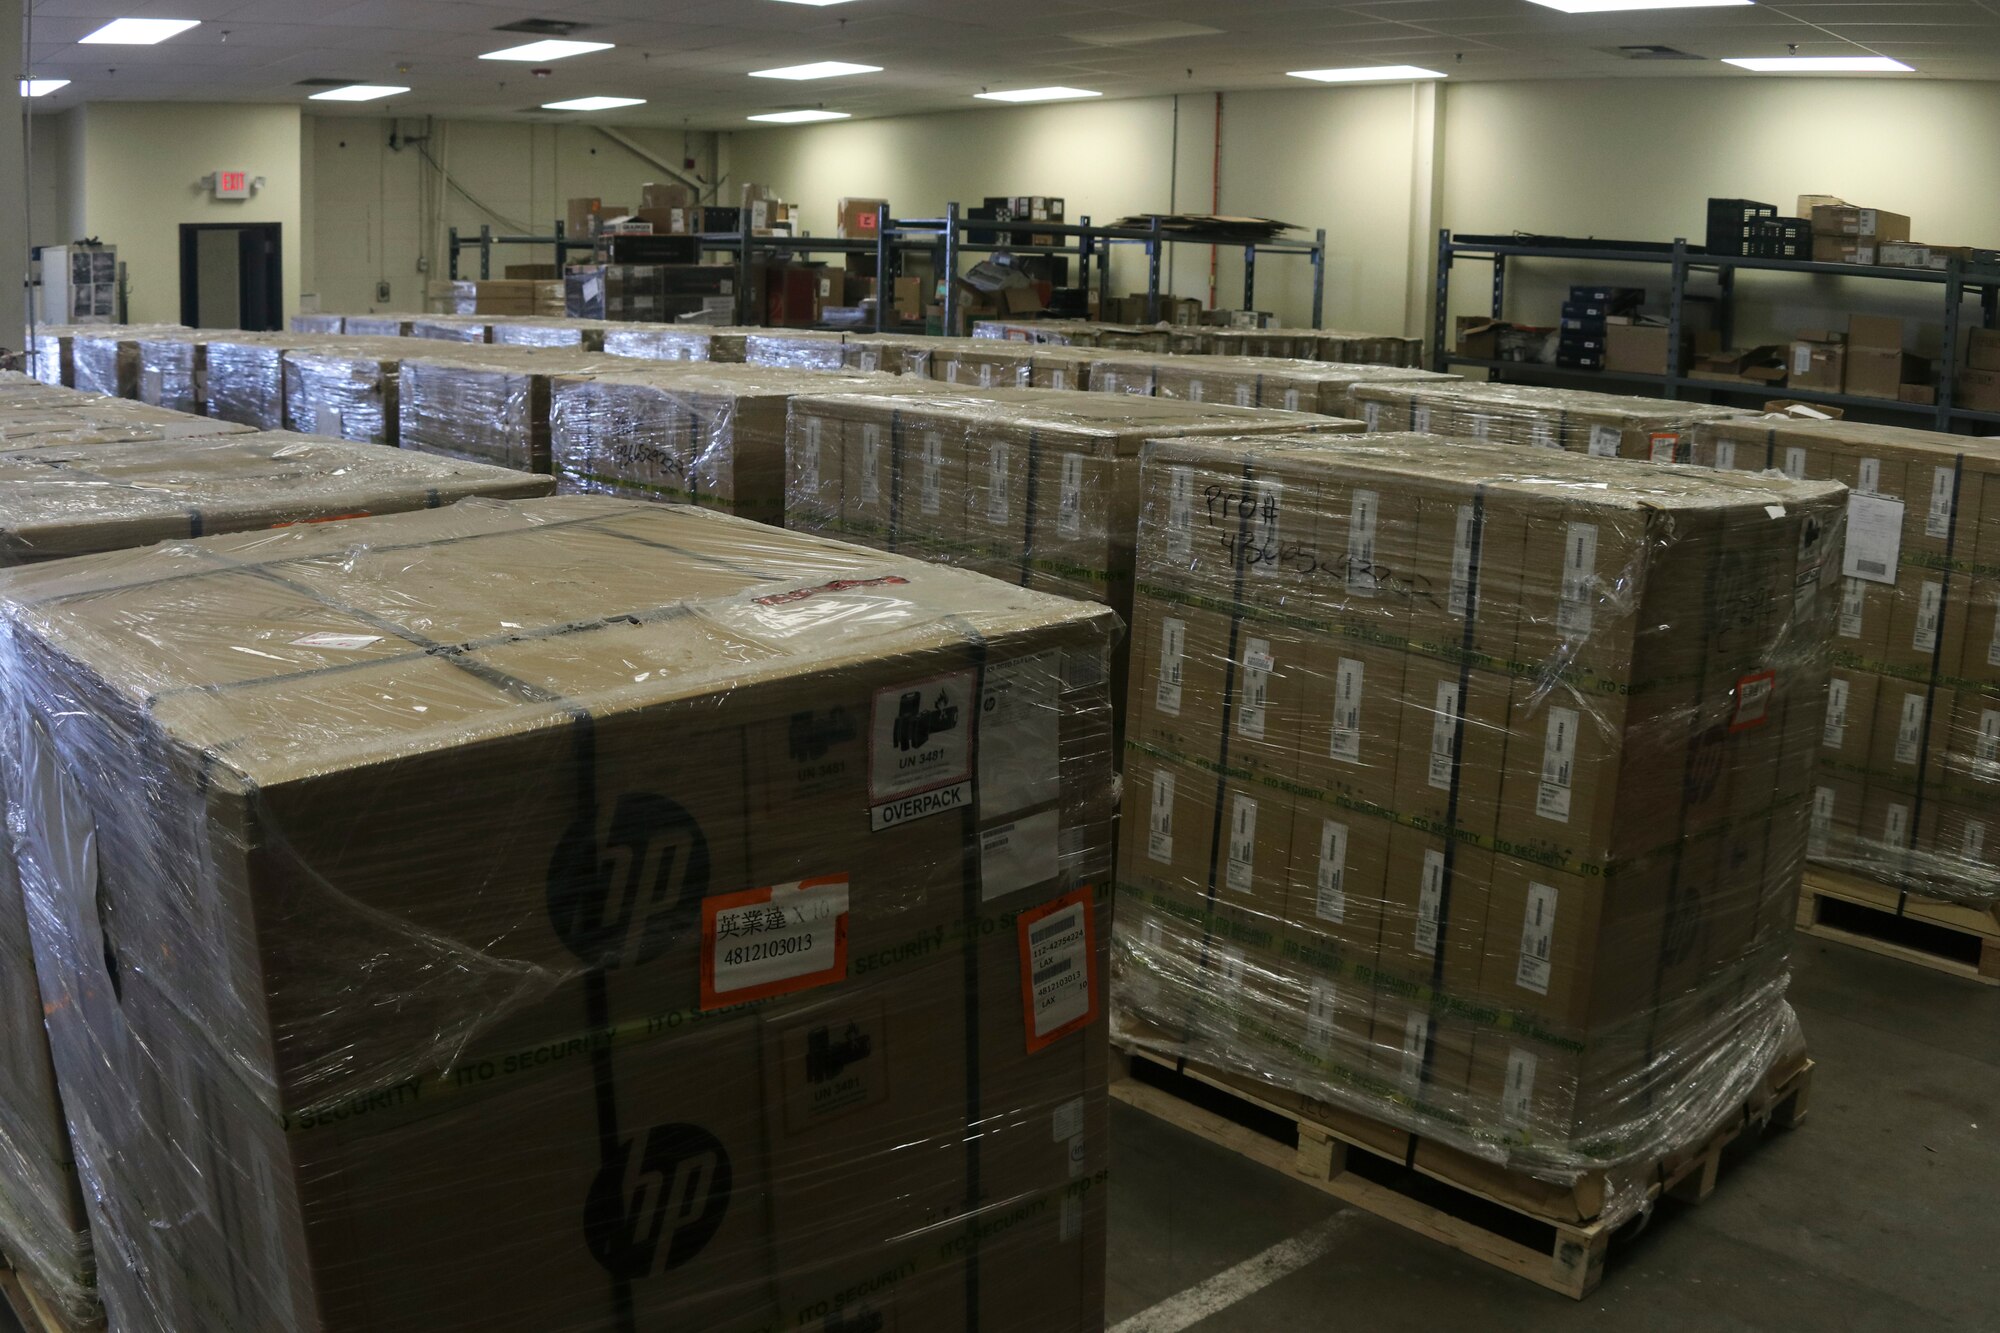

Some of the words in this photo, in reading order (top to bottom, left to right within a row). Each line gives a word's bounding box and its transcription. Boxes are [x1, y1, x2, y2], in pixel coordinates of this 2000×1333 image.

[222, 171, 245, 191] EXIT
[899, 756, 917, 769] UN
[919, 748, 945, 764] 3481
[798, 767, 815, 781] UN
[1264, 777, 1278, 788] ITO
[1280, 780, 1325, 800] SECURITY
[883, 787, 962, 823] OVERPACK
[1412, 816, 1428, 831] ITO
[1431, 822, 1480, 844] SECURITY
[1496, 840, 1511, 852] ITO
[1513, 844, 1568, 867] SECURITY
[717, 906, 787, 941] 英業達
[813, 900, 830, 921] 10
[724, 933, 812, 965] 4812103013
[855, 932, 945, 976] SECURITY
[1039, 956, 1054, 969] LAX
[1038, 970, 1081, 996] 4812103013
[1079, 980, 1088, 990] 10
[1041, 996, 1056, 1008] LAX
[648, 1011, 683, 1034] ITO
[455, 1062, 495, 1086] ITO
[503, 1028, 617, 1074] SECURITY
[299, 1077, 424, 1129] SECURITY
[815, 1089, 832, 1102] UN
[604, 1128, 718, 1279] hp
[941, 1235, 967, 1259] ITO
[971, 1198, 1048, 1241] SECURITY
[798, 1301, 828, 1325] ITO
[834, 1263, 916, 1309] SECURITY
